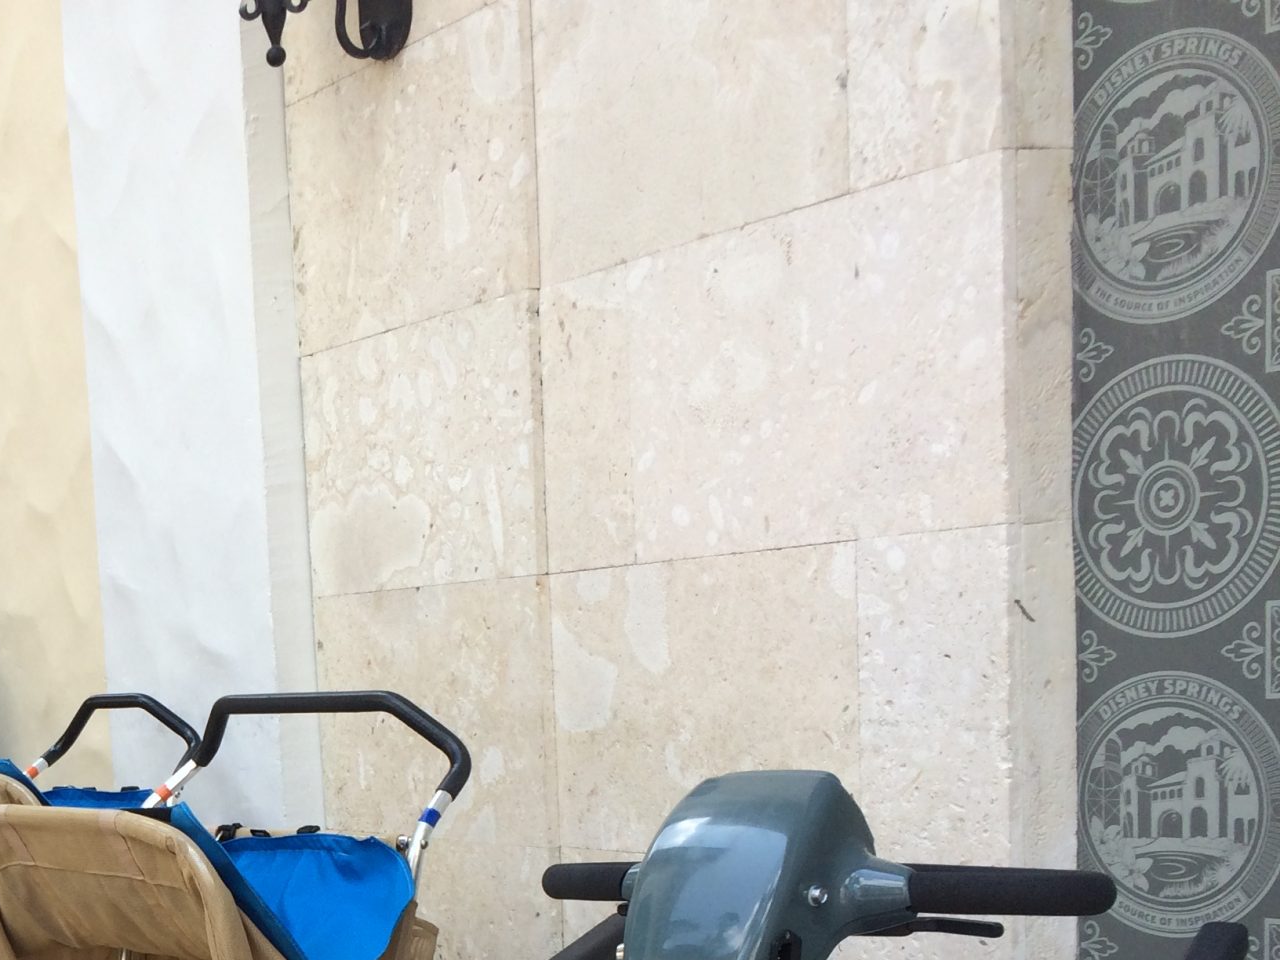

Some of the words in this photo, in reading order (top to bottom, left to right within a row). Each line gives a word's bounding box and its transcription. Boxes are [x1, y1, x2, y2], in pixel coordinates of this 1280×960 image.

[1094, 46, 1155, 104] DISNEY
[1160, 37, 1242, 67] SPRINGS
[1094, 285, 1112, 303] THE
[1113, 297, 1153, 313] SOURCE
[1156, 299, 1170, 312] OF
[1173, 256, 1245, 308] INSPIRATION
[1098, 680, 1159, 721] DISNEY
[1163, 679, 1243, 720] SPRINGS
[1118, 900, 1157, 926] SOURCE
[1159, 915, 1173, 927] OF
[1176, 895, 1242, 927] INSPIRATION
